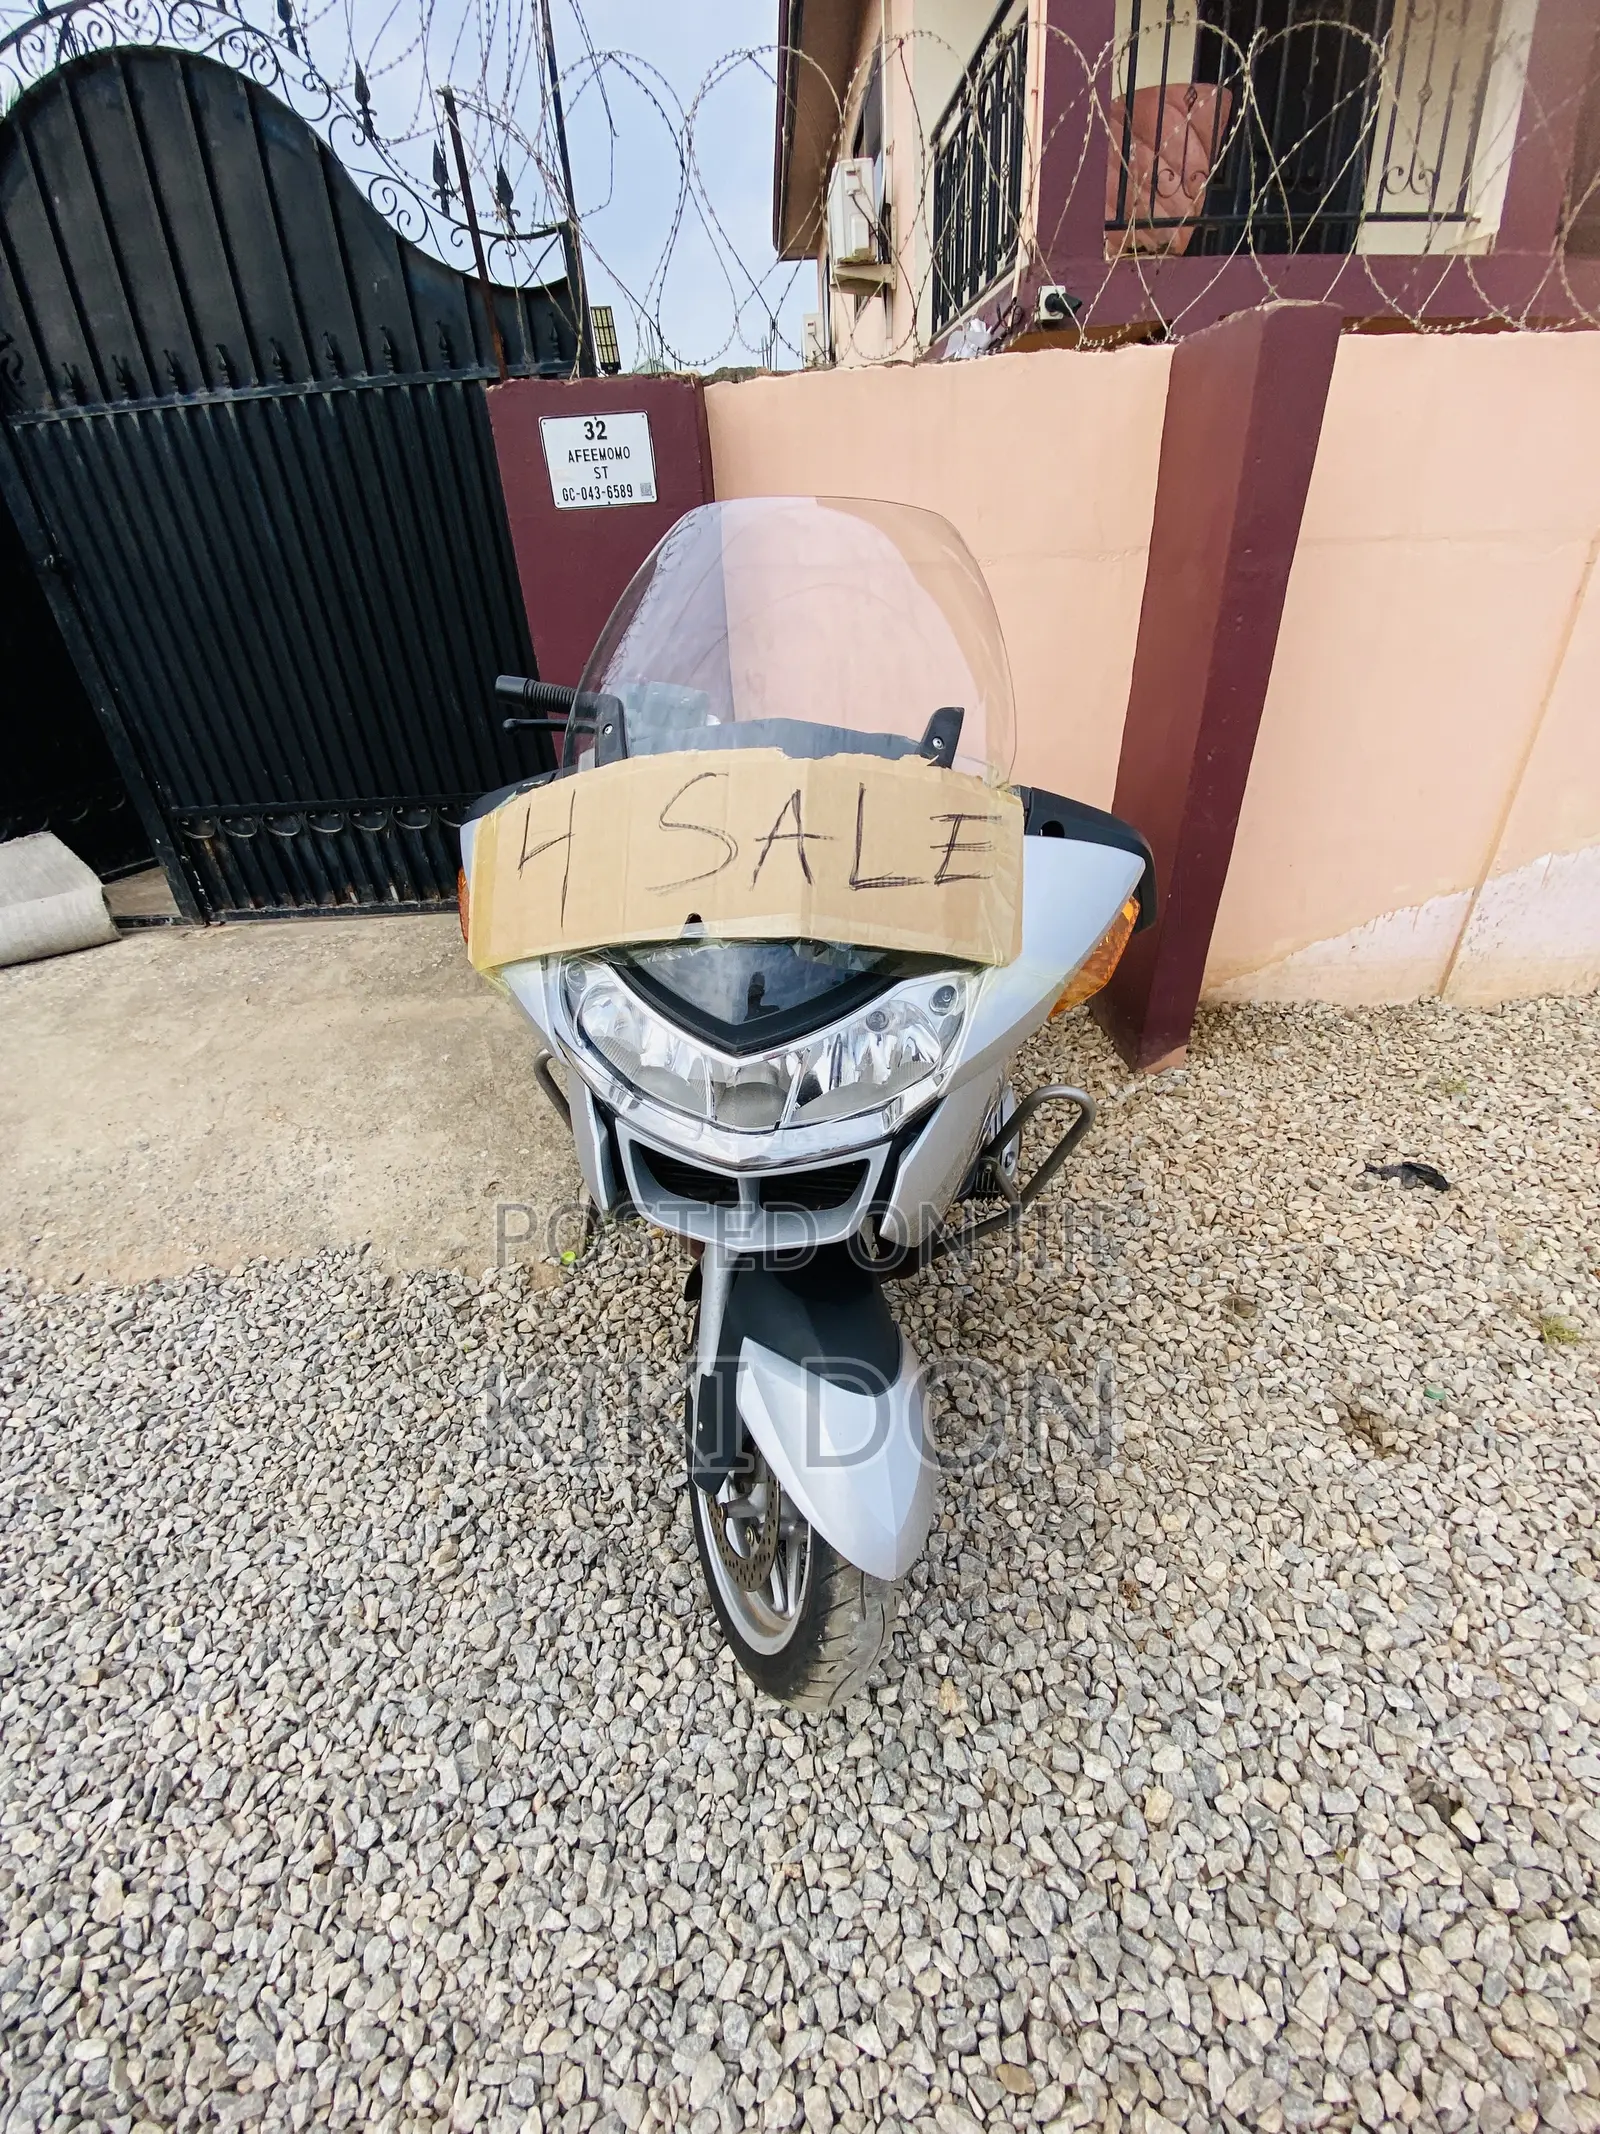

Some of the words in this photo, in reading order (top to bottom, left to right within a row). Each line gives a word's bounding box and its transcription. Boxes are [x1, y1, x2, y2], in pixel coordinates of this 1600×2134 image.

[584, 421, 607, 440] 32
[568, 446, 630, 463] AFEEMOMO
[593, 466, 608, 479] ST
[562, 484, 633, 501] GC-043-6589
[518, 789, 577, 931] 4
[646, 771, 1002, 894] SALE
